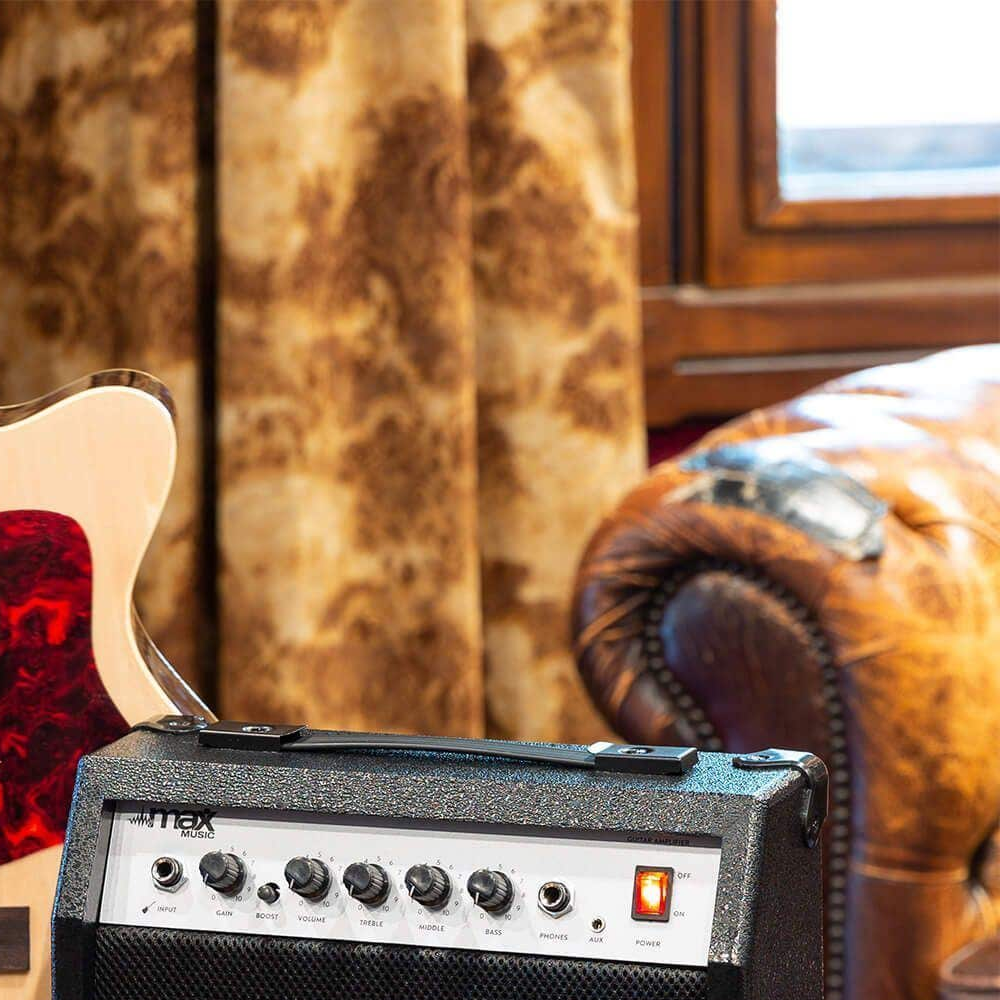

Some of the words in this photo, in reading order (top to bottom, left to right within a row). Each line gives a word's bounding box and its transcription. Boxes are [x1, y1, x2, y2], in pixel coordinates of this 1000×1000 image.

[149, 808, 217, 831] max
[181, 830, 215, 839] MUSIC
[677, 872, 691, 880] OFF
[256, 912, 280, 920] BOOST
[673, 910, 685, 918] ON
[297, 915, 326, 923] VOLUME
[359, 919, 384, 928] TREBLE
[418, 924, 445, 933] MIDDLE
[485, 928, 503, 936] BASS
[539, 932, 569, 941] PHONES
[588, 936, 604, 944] AUX
[635, 939, 662, 948] POWER
